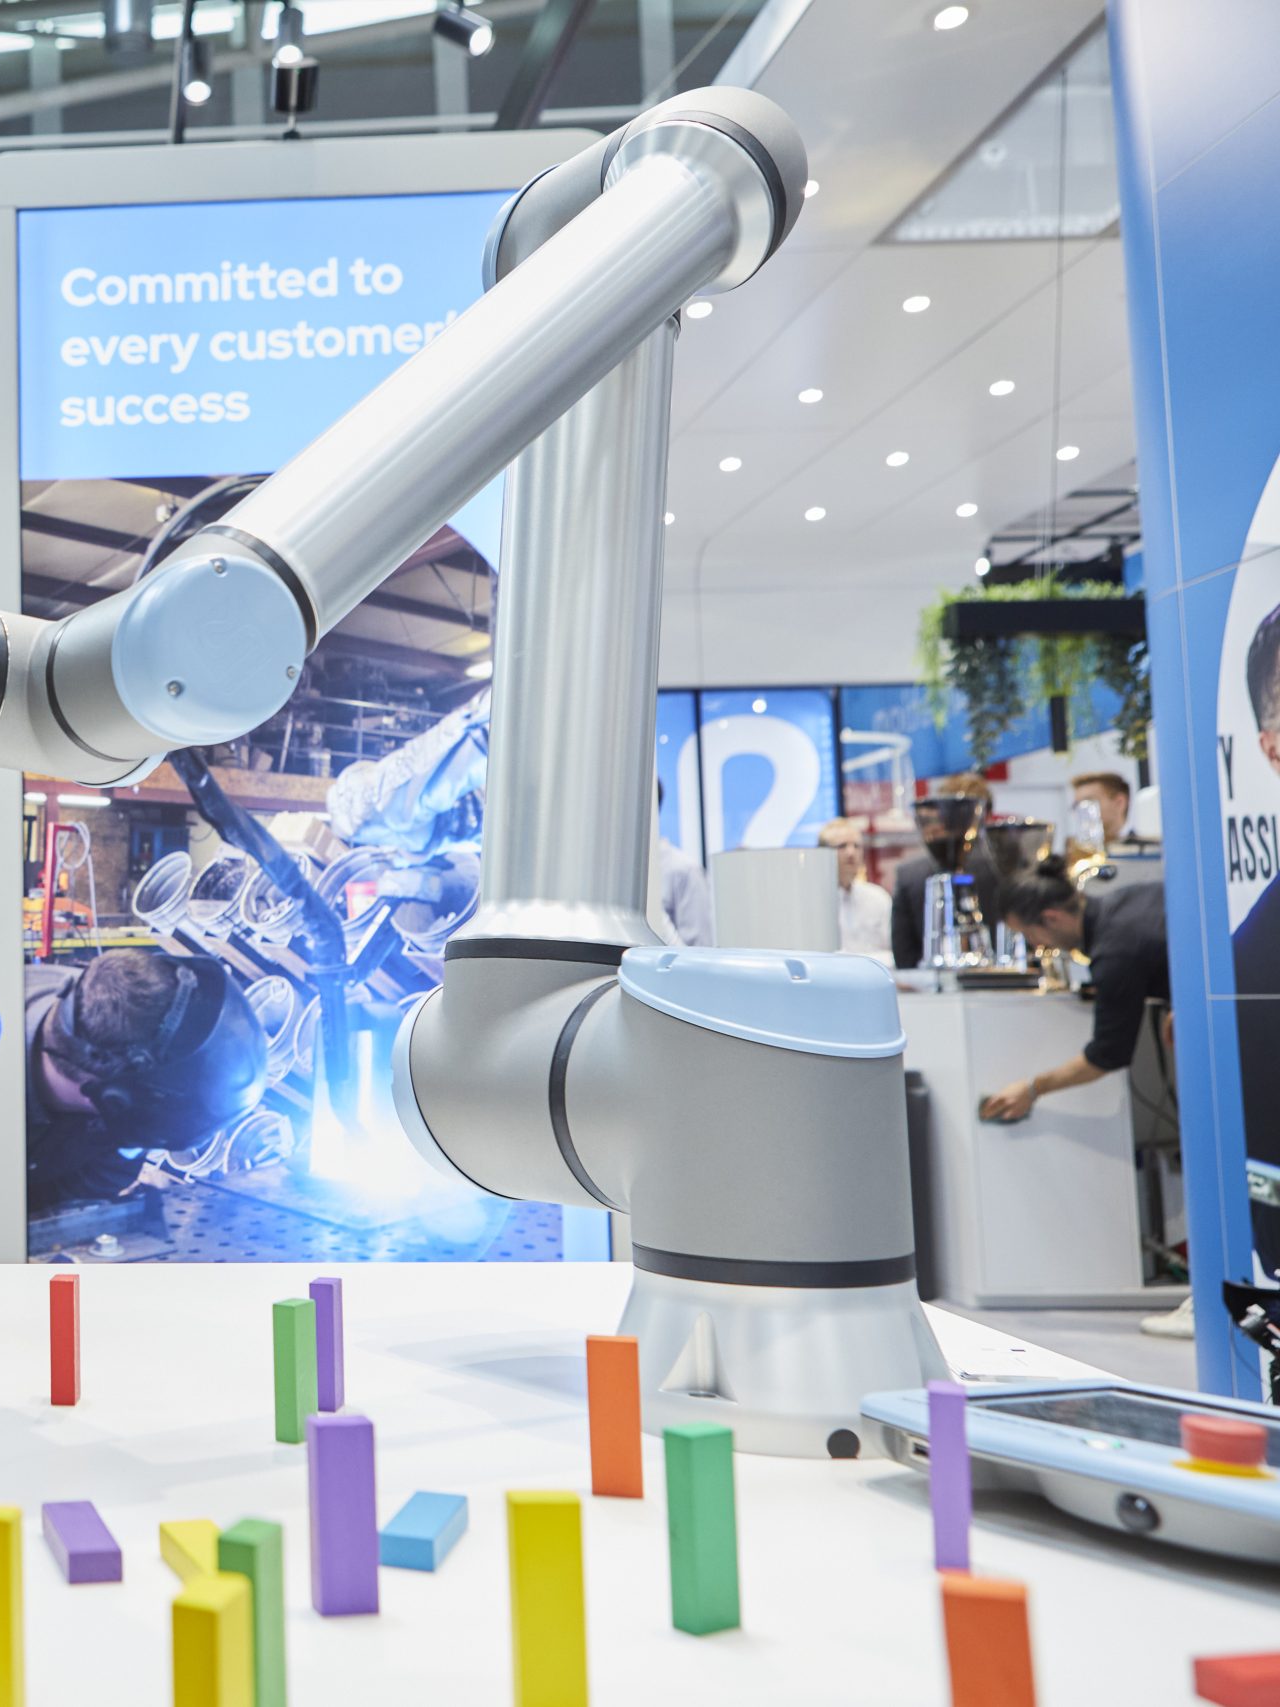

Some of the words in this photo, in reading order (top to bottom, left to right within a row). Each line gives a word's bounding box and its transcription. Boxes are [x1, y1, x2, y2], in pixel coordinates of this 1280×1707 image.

[60, 257, 338, 307] Committed
[349, 258, 403, 296] to
[60, 332, 200, 374] every
[60, 391, 251, 428] success
